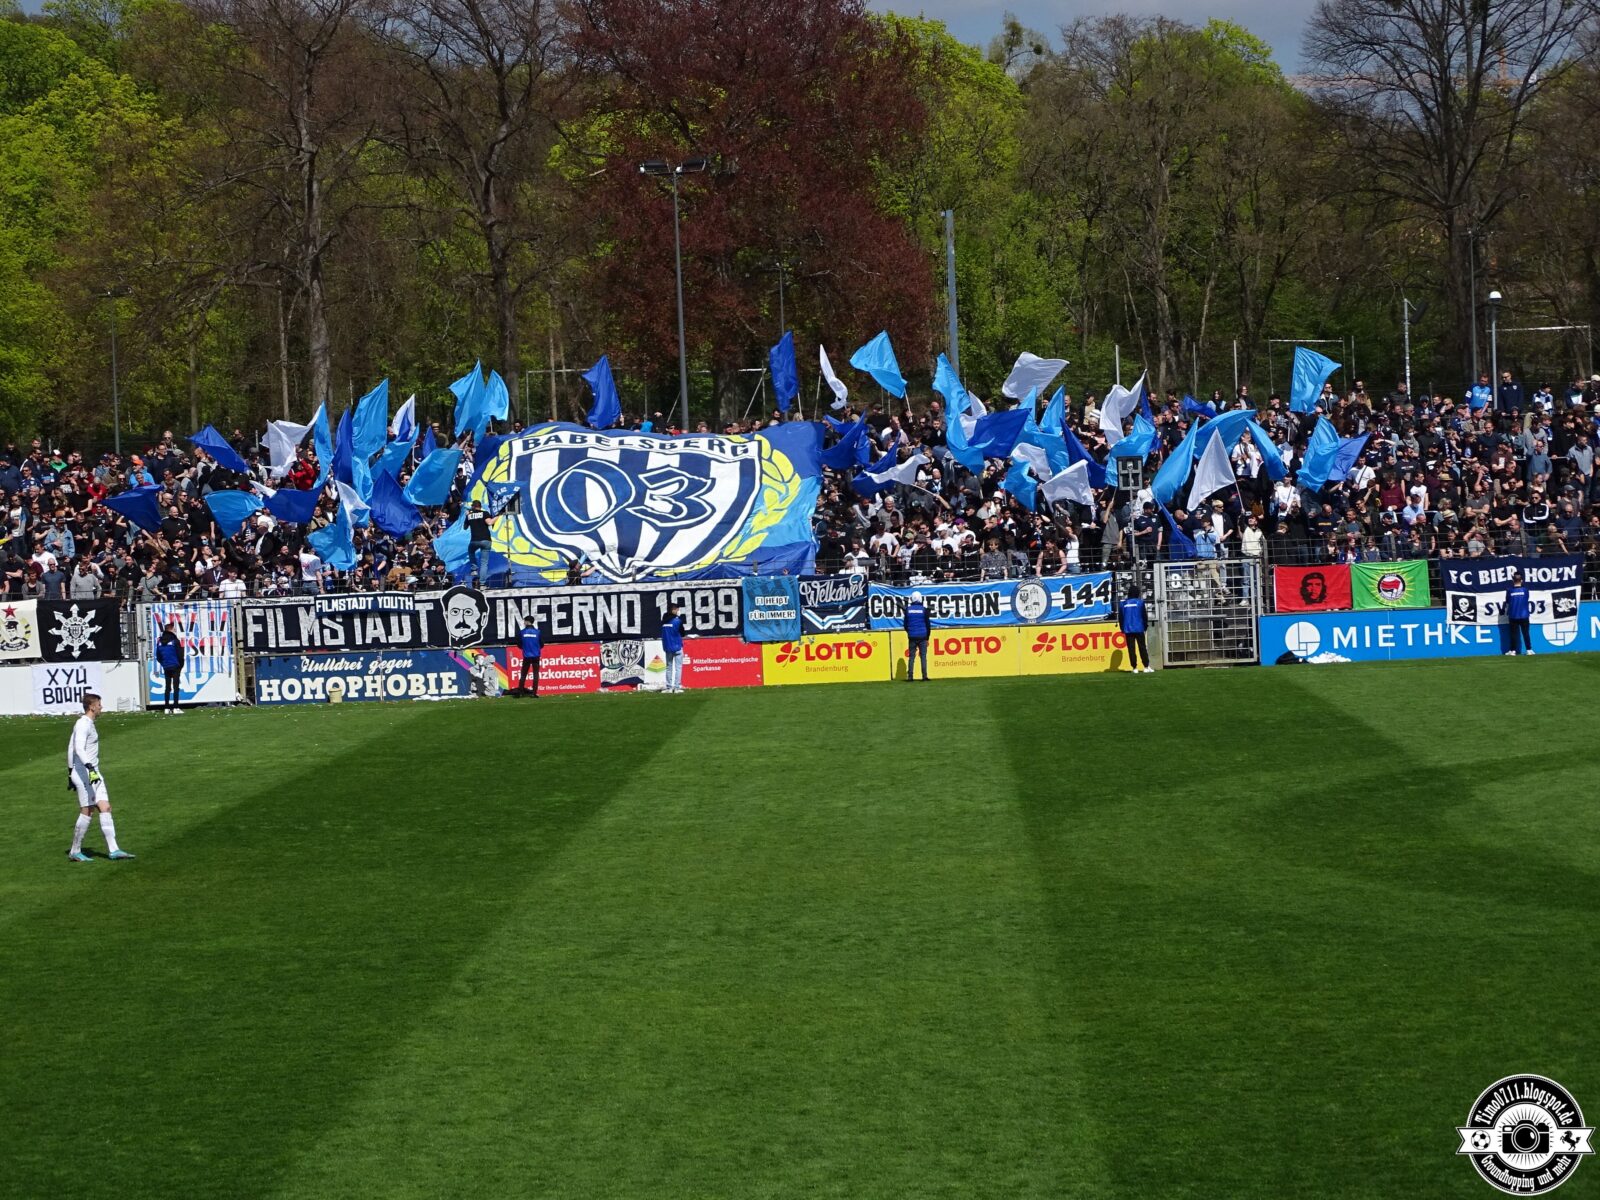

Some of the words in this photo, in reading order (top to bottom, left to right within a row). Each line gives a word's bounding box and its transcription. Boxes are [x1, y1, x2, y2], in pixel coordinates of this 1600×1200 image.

[521, 431, 749, 457] BABELSBERG
[541, 457, 716, 534] 03
[1449, 569, 1473, 586] FC
[316, 598, 373, 613] FILMSTADT
[377, 596, 414, 610] YOUTH
[869, 591, 1001, 619] CONECTION
[1060, 581, 1112, 612] 144
[245, 602, 434, 648] FILMSTADT
[496, 594, 641, 640] INFERNO
[655, 587, 739, 632] 1999
[749, 610, 765, 620] FÜR
[766, 610, 796, 619] IMMER!
[1061, 631, 1128, 651] LOTTO
[1332, 622, 1493, 647] MIETHKE
[805, 643, 873, 661] LOTTO
[933, 636, 1002, 656] LOTTO
[300, 656, 364, 673] Nulldrei
[368, 658, 414, 675] gegen
[540, 655, 600, 669] parkassen
[692, 656, 759, 665] Mittelbrandenburgische
[934, 660, 978, 668] Brandenburg
[1061, 655, 1106, 663] Brandenburg
[692, 665, 721, 673] Sparkasse
[805, 665, 849, 673] Brandenburg
[259, 671, 459, 702] HOMOPHOBIE
